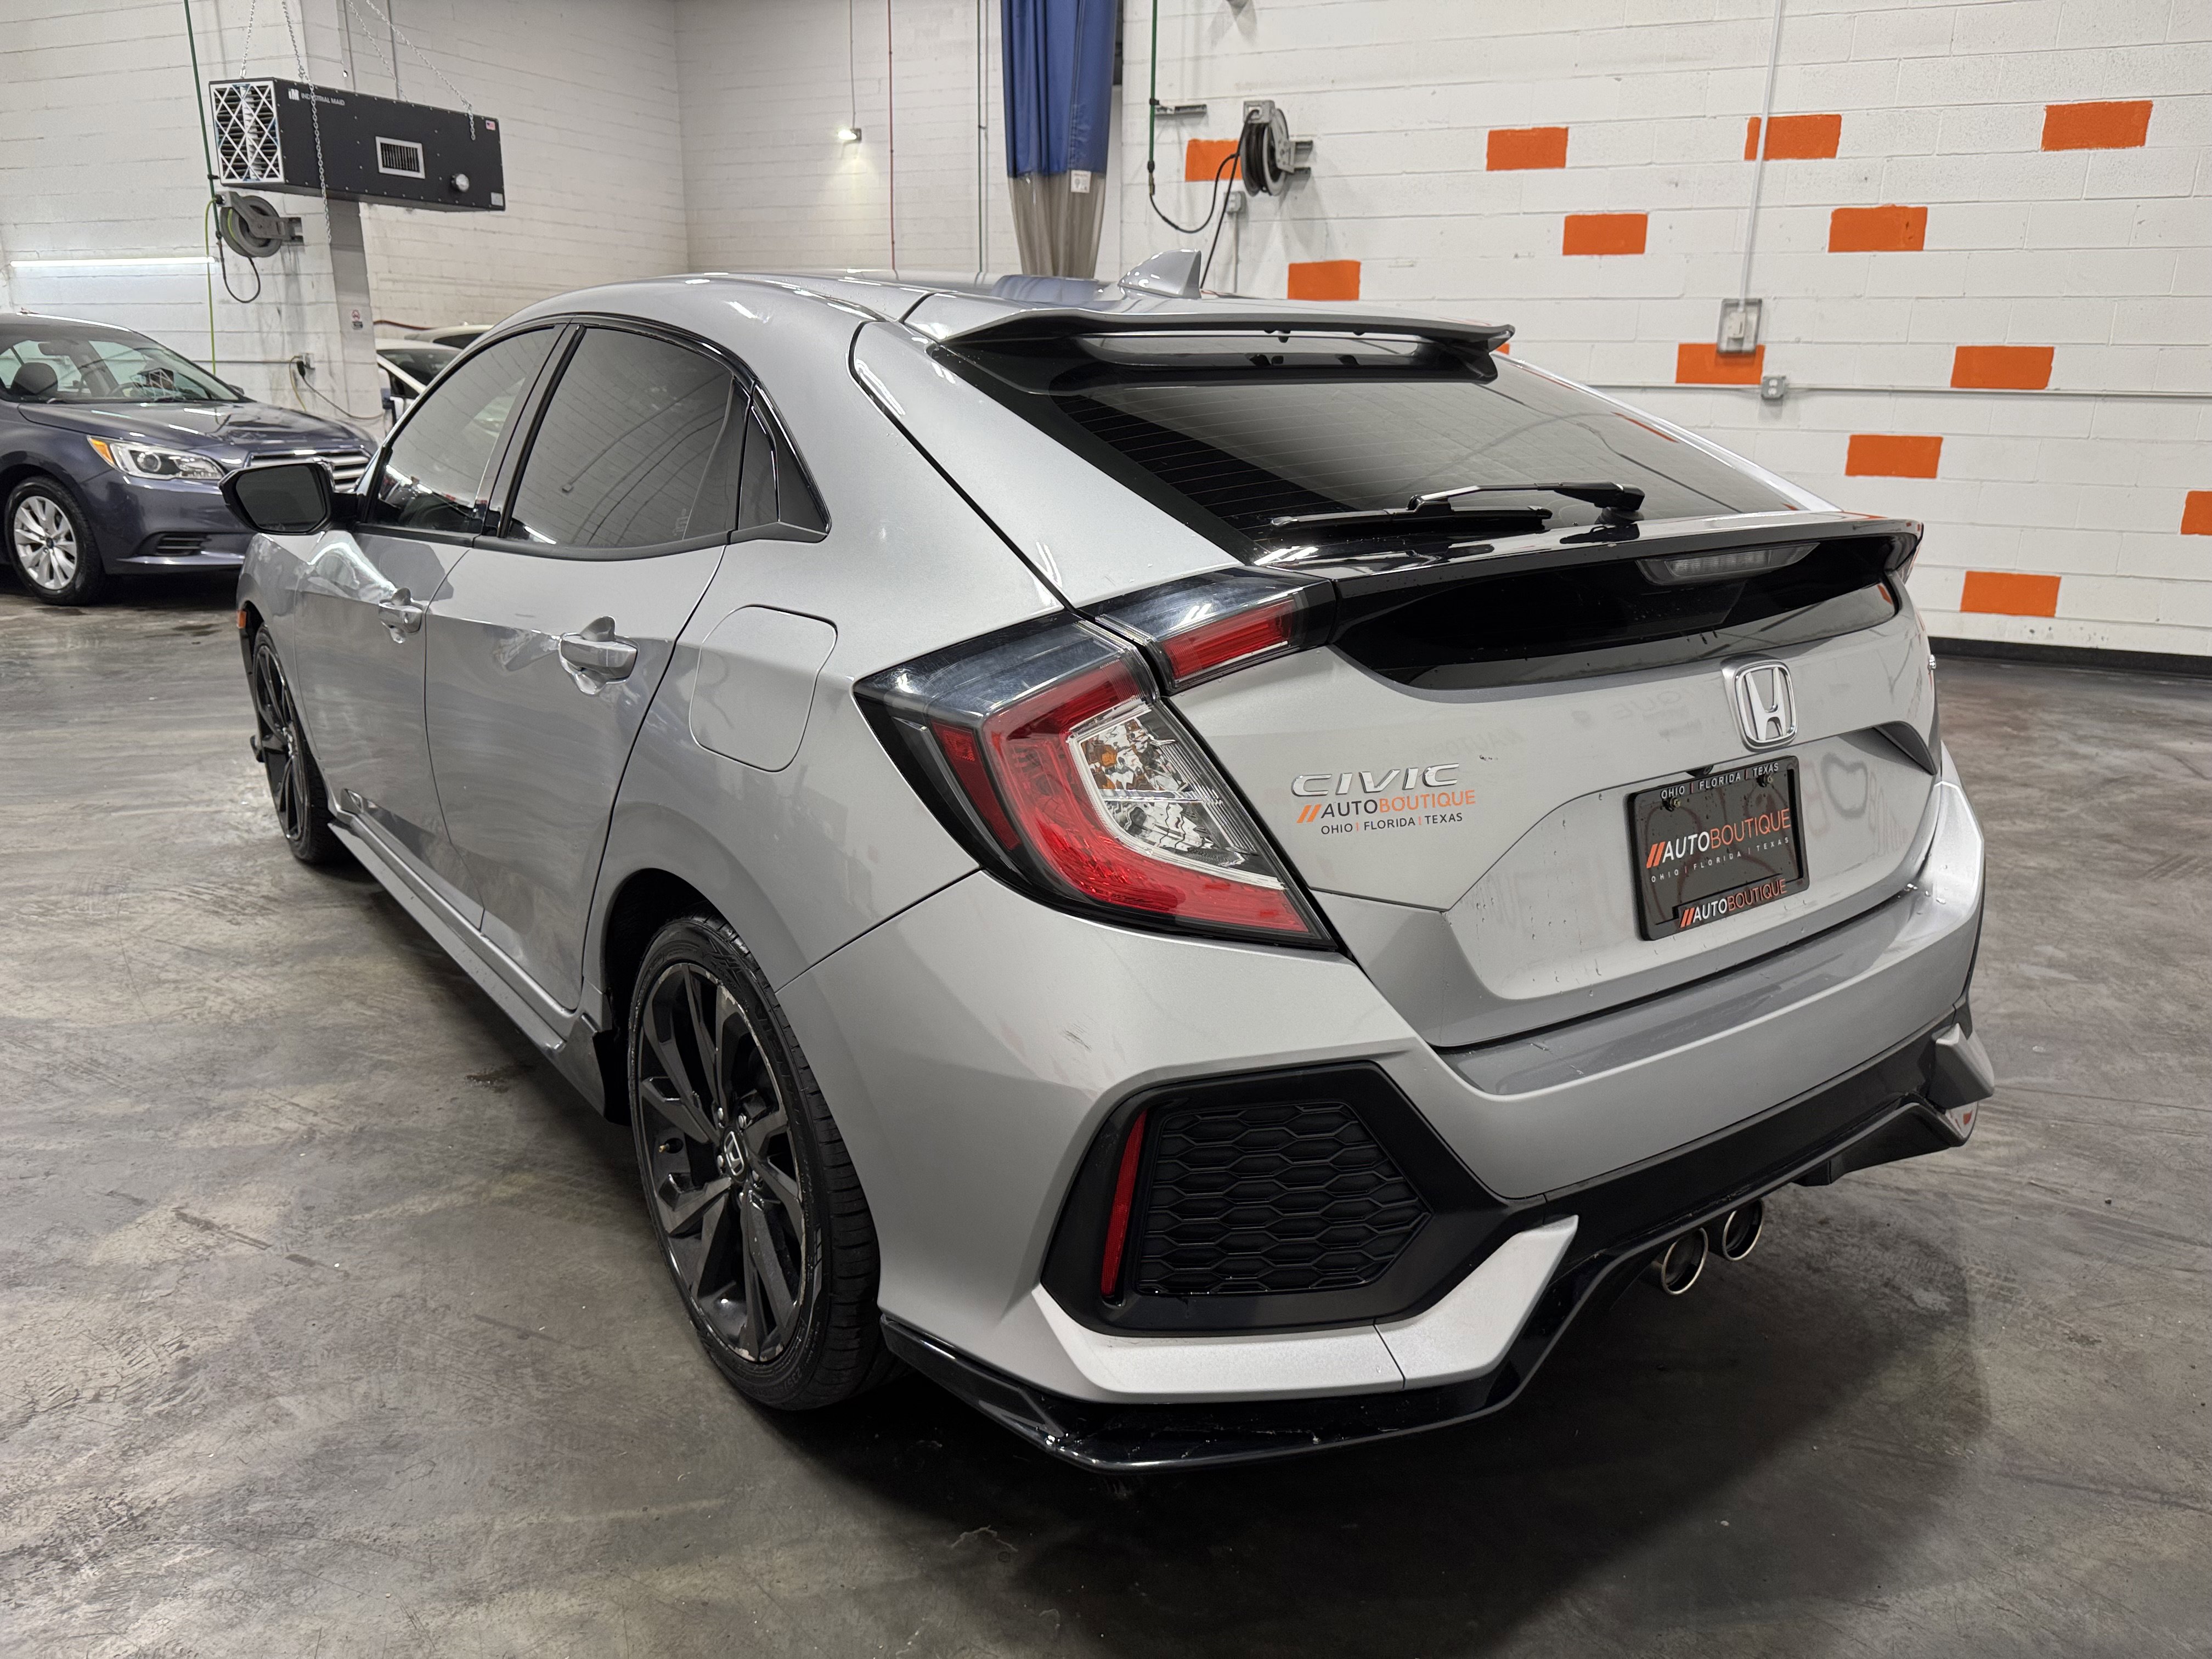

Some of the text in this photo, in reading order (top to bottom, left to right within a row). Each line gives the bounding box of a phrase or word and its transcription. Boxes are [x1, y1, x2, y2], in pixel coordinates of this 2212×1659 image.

[301, 92, 331, 104] INDSTRIAL
[330, 97, 346, 106] MAID
[1291, 763, 1459, 797] CIVIC
[1660, 762, 1779, 799] OHIO FLORIDA TEXAS
[1321, 812, 1464, 835] OHIO FLORIDA TEXAS
[1651, 836, 1790, 883] OHIO FLORIDA TEXAS
